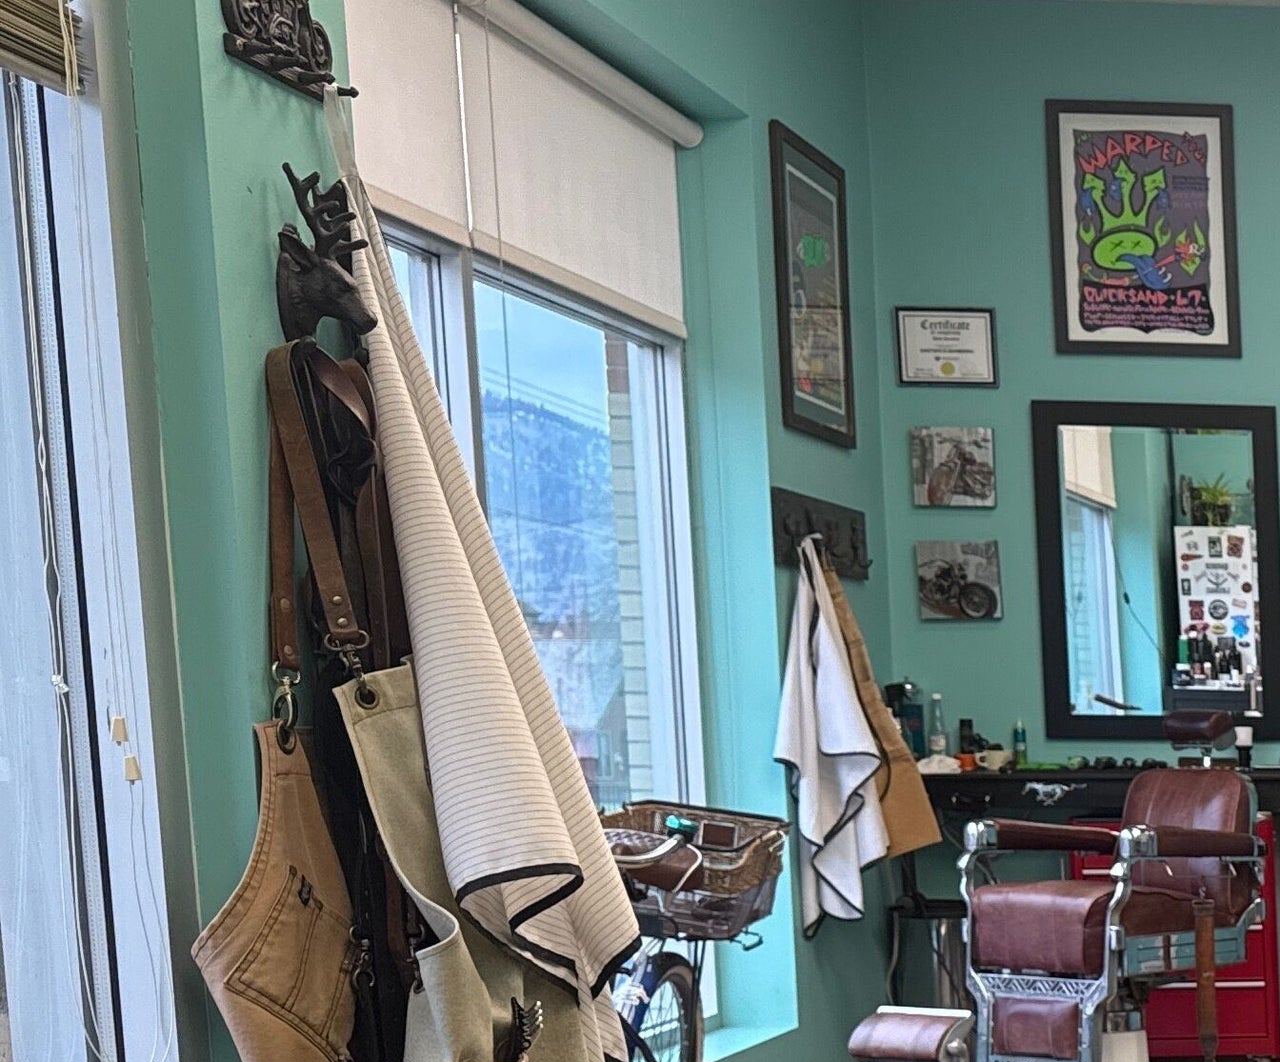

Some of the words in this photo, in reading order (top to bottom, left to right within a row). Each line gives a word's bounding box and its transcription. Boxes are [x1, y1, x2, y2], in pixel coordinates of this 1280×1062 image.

[1078, 131, 1189, 174] WARPED
[1083, 286, 1169, 305] QUICKSAND
[920, 319, 970, 330] Certificate
